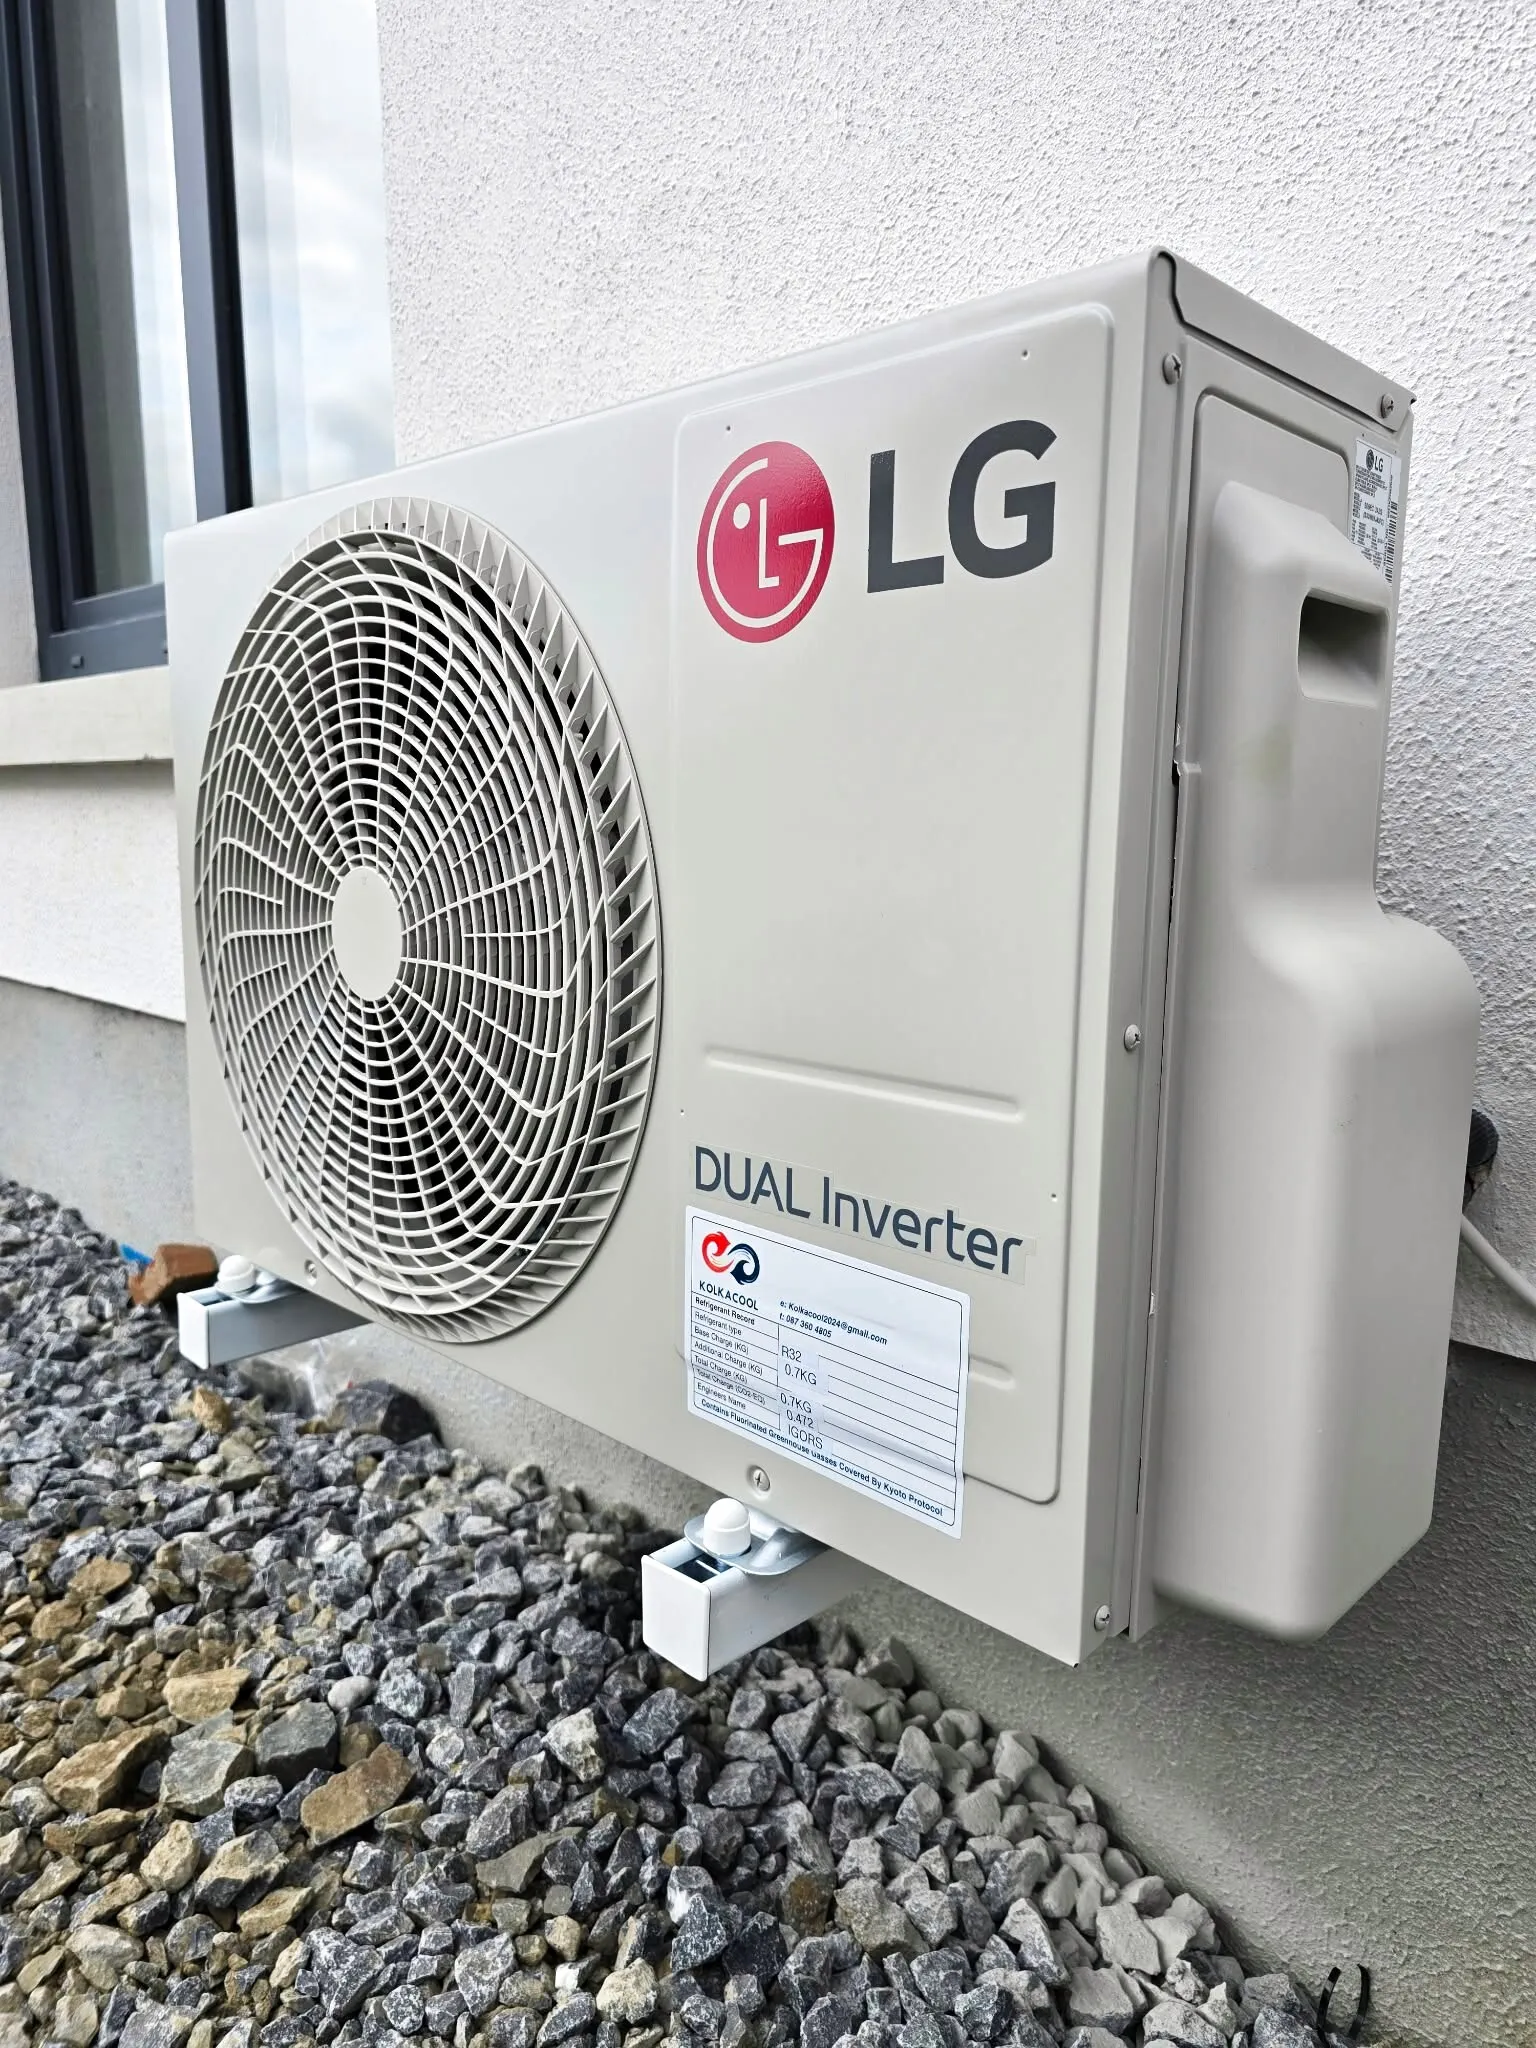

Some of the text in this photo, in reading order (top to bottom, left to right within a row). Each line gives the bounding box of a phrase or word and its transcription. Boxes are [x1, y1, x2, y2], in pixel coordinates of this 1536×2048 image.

[1374, 455, 1384, 473] LG
[867, 420, 1057, 593] LG
[695, 1145, 1024, 1275] DUAL Inverter
[699, 1280, 759, 1311] KOLKACOOL
[694, 1311, 742, 1336] Refrigerant type
[695, 1297, 755, 1326] Refrigerant Record
[788, 1302, 888, 1345] Kolkacool2024@gmail.com
[786, 1314, 800, 1326] 087
[800, 1320, 813, 1331] 360
[814, 1326, 832, 1338] 4805
[694, 1326, 749, 1355] Base Charge (KG)
[780, 1345, 802, 1363] R32
[694, 1341, 763, 1377] Additional Charge (KG)
[694, 1355, 748, 1385] Total Charge (KG)
[696, 1368, 711, 1380] Total
[711, 1374, 734, 1390] Charge
[784, 1363, 817, 1386] 0.7KG
[697, 1382, 746, 1410] Engineers Name
[780, 1392, 812, 1414] 0.7KG
[786, 1409, 814, 1429] 0.472
[788, 1424, 823, 1450] IGORS
[701, 1398, 729, 1417] Contains
[730, 1411, 767, 1433] Fluorinated
[839, 1462, 870, 1483] Covered
[871, 1476, 882, 1489] By
[883, 1482, 907, 1500] Kyoto
[908, 1491, 943, 1516] Protocol
